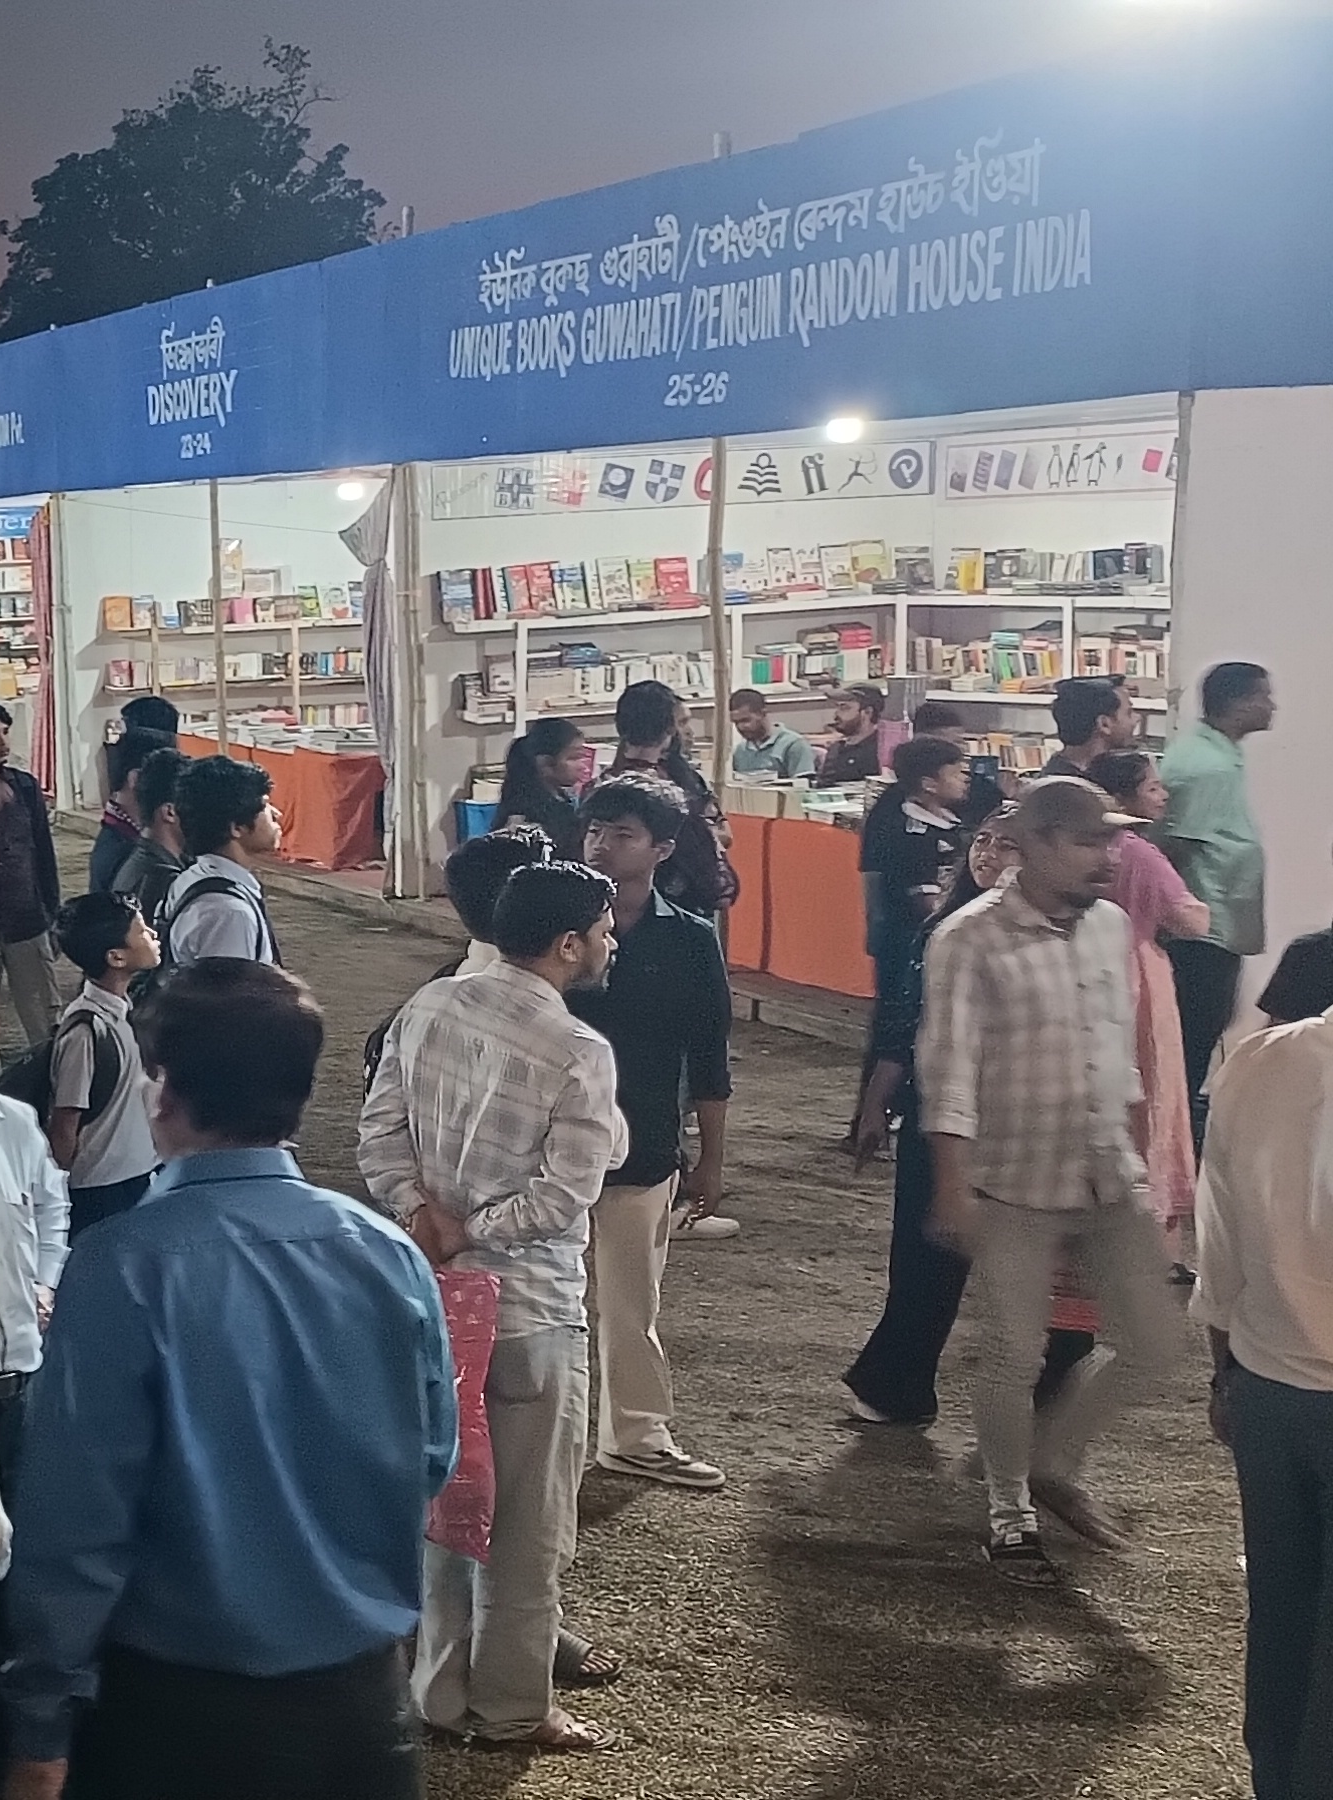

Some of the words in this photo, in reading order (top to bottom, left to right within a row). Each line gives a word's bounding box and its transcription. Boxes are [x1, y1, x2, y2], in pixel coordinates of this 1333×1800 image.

[449, 320, 512, 382] UNIQUE
[516, 310, 576, 379] BOOKS
[788, 247, 900, 347] RANDOM
[907, 226, 1006, 313] HOUSE
[1012, 208, 1092, 297] INDIA
[147, 369, 239, 428] DISCOVERY
[663, 371, 730, 407] 25-26
[179, 432, 212, 460] 23-24
